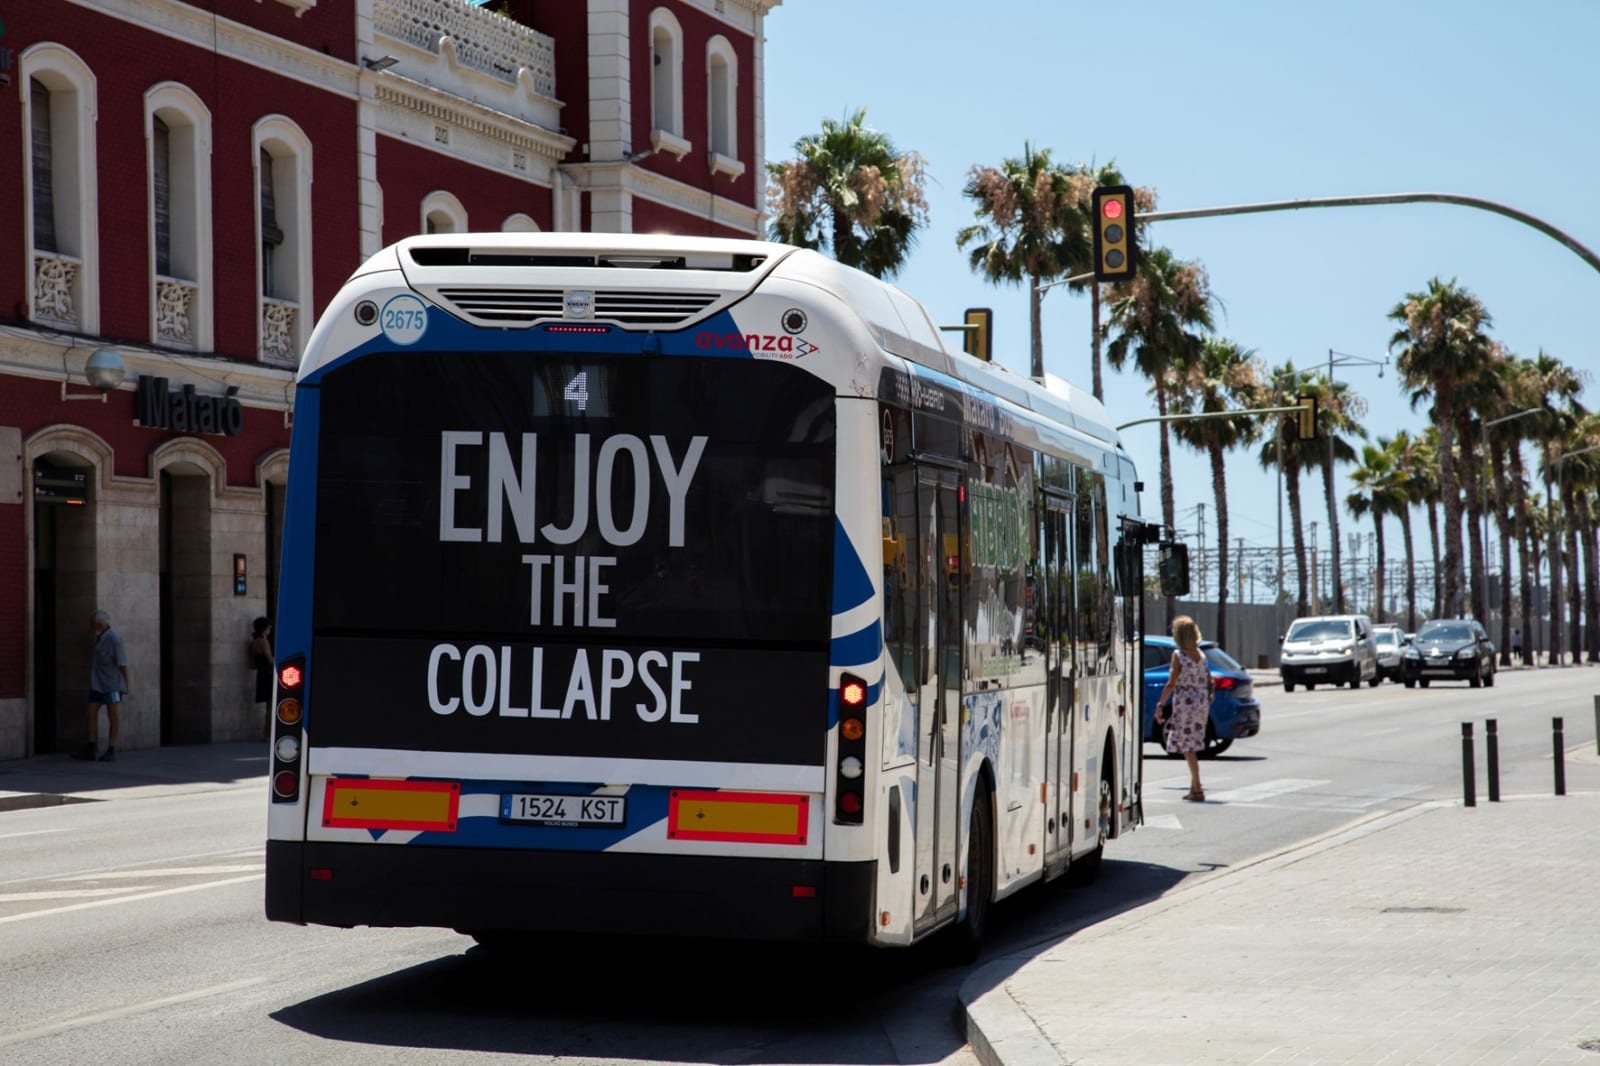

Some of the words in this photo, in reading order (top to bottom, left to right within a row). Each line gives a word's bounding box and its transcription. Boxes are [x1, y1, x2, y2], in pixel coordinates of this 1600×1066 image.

[385, 309, 424, 330] 2675
[695, 331, 793, 352] avanza
[138, 374, 243, 436] Mataró
[564, 371, 588, 411] 4
[440, 430, 709, 547] ENJOY
[521, 554, 617, 628] THE
[427, 643, 701, 724] COLLAPSE
[520, 797, 566, 819] 1524
[581, 799, 619, 821] KST
